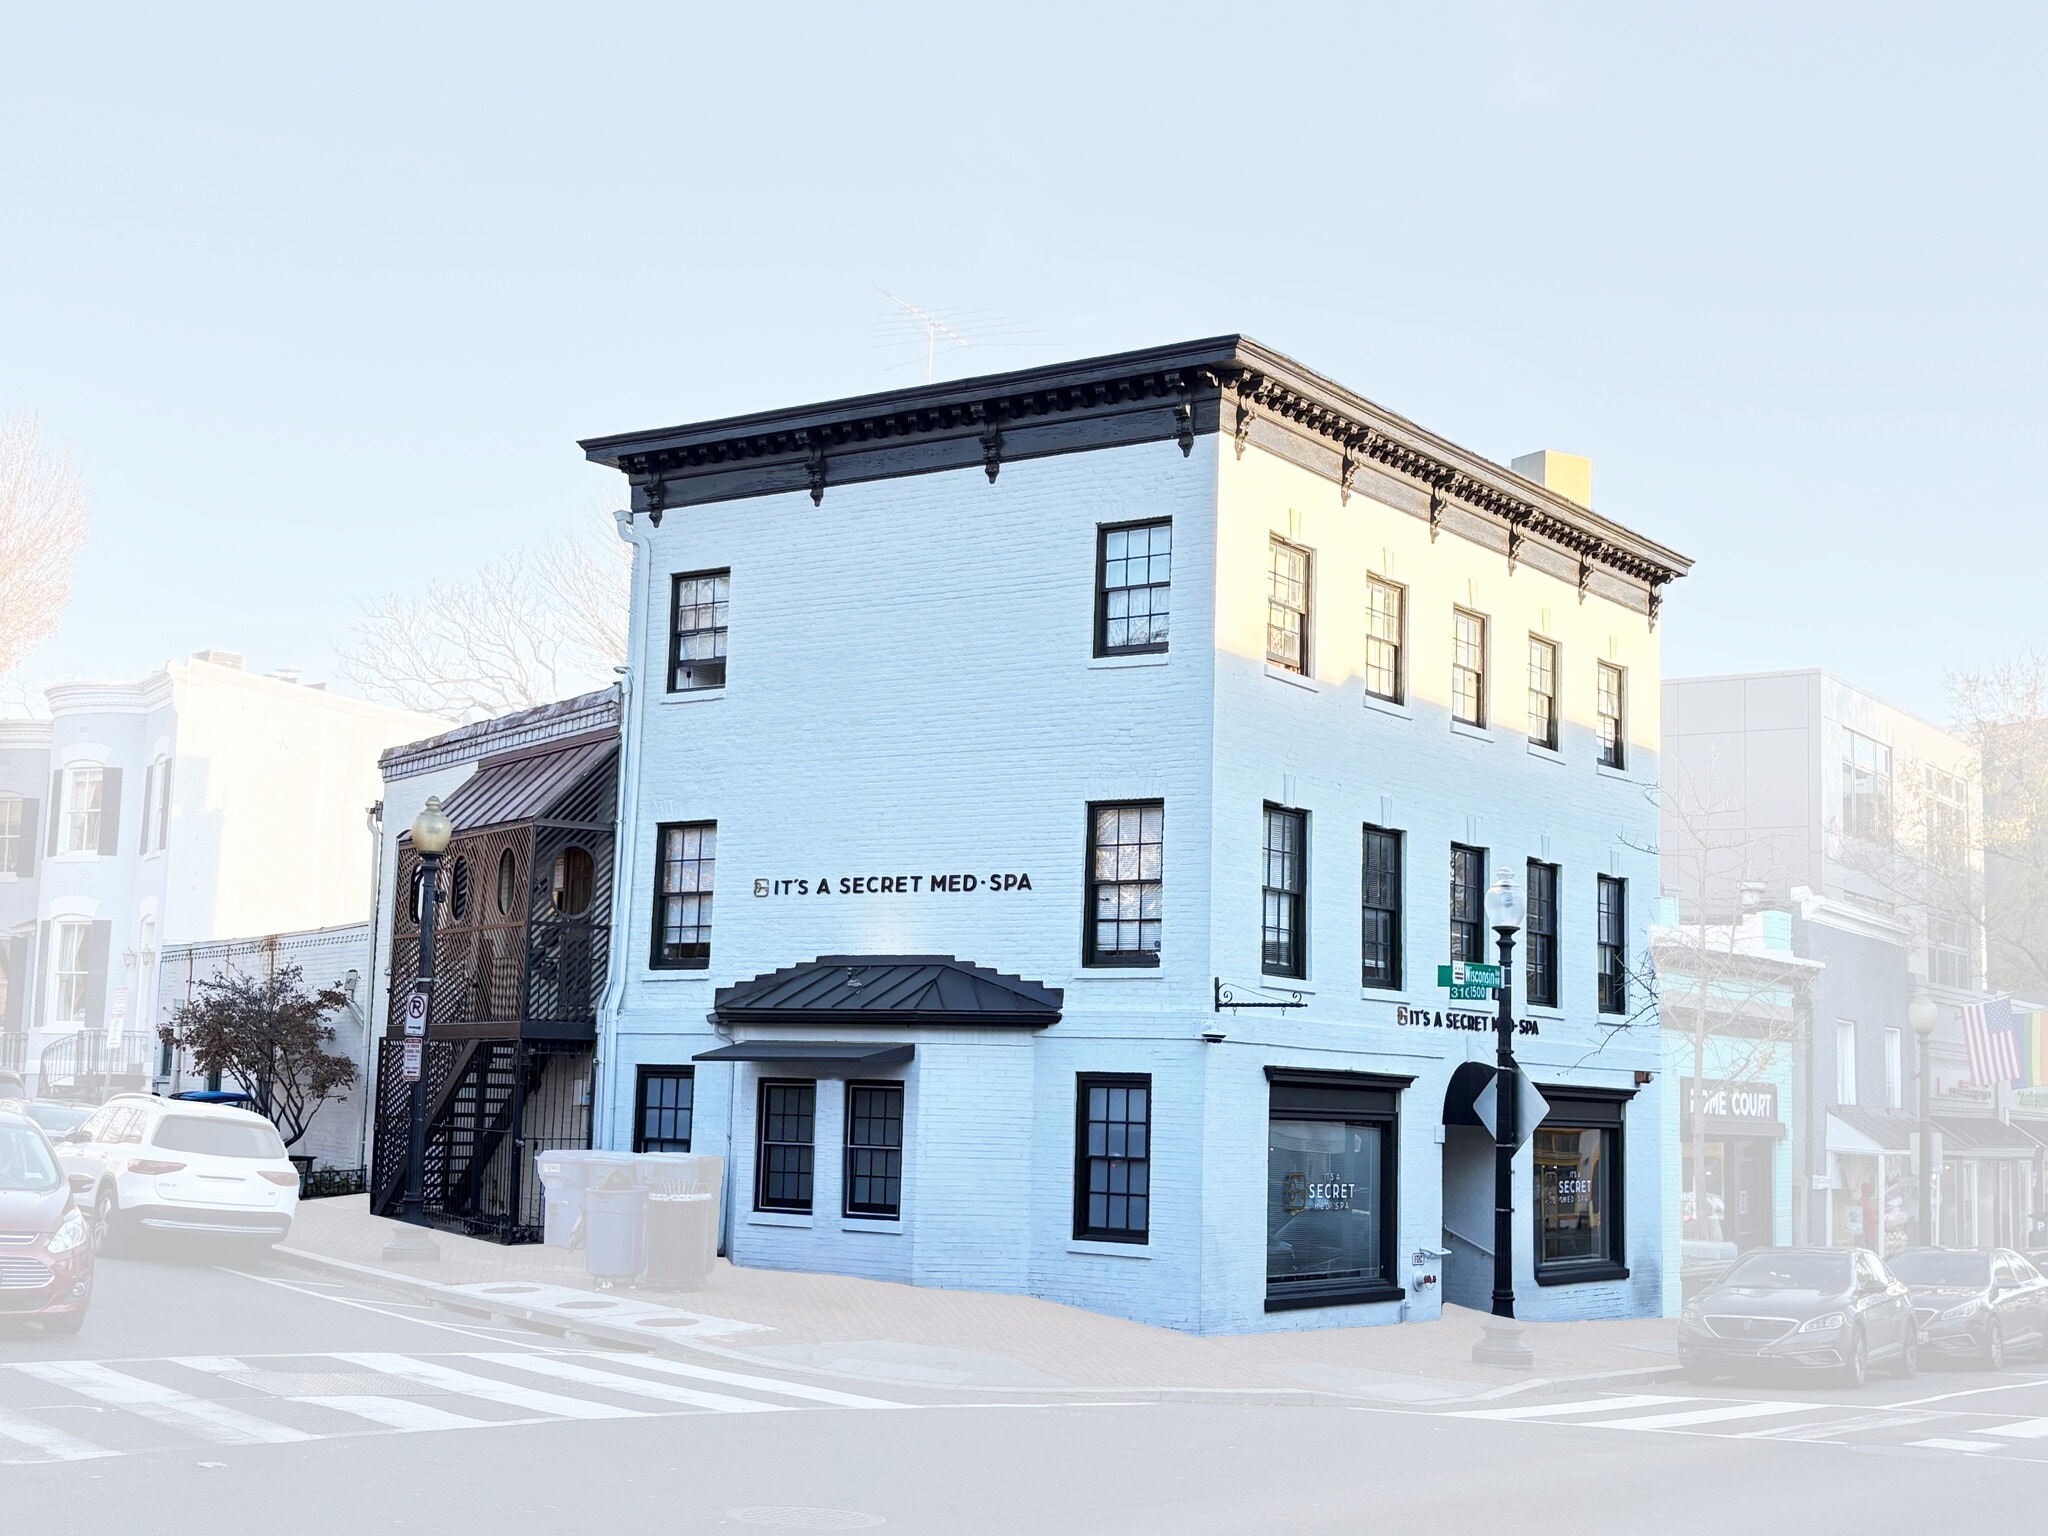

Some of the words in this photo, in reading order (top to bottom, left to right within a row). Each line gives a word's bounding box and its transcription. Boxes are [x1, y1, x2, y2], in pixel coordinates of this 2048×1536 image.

[774, 878, 809, 896] IT'S
[816, 878, 831, 895] A
[839, 875, 923, 894] SECRET
[1464, 965, 1495, 985] Wisconsin
[1470, 985, 1485, 998] 1500
[1434, 1011, 1443, 1028] A
[1446, 1012, 1488, 1032] SECRET
[1731, 1092, 1772, 1118] COURT
[1309, 1183, 1355, 1199] SECRET
[1558, 1180, 1592, 1193] SECRET
